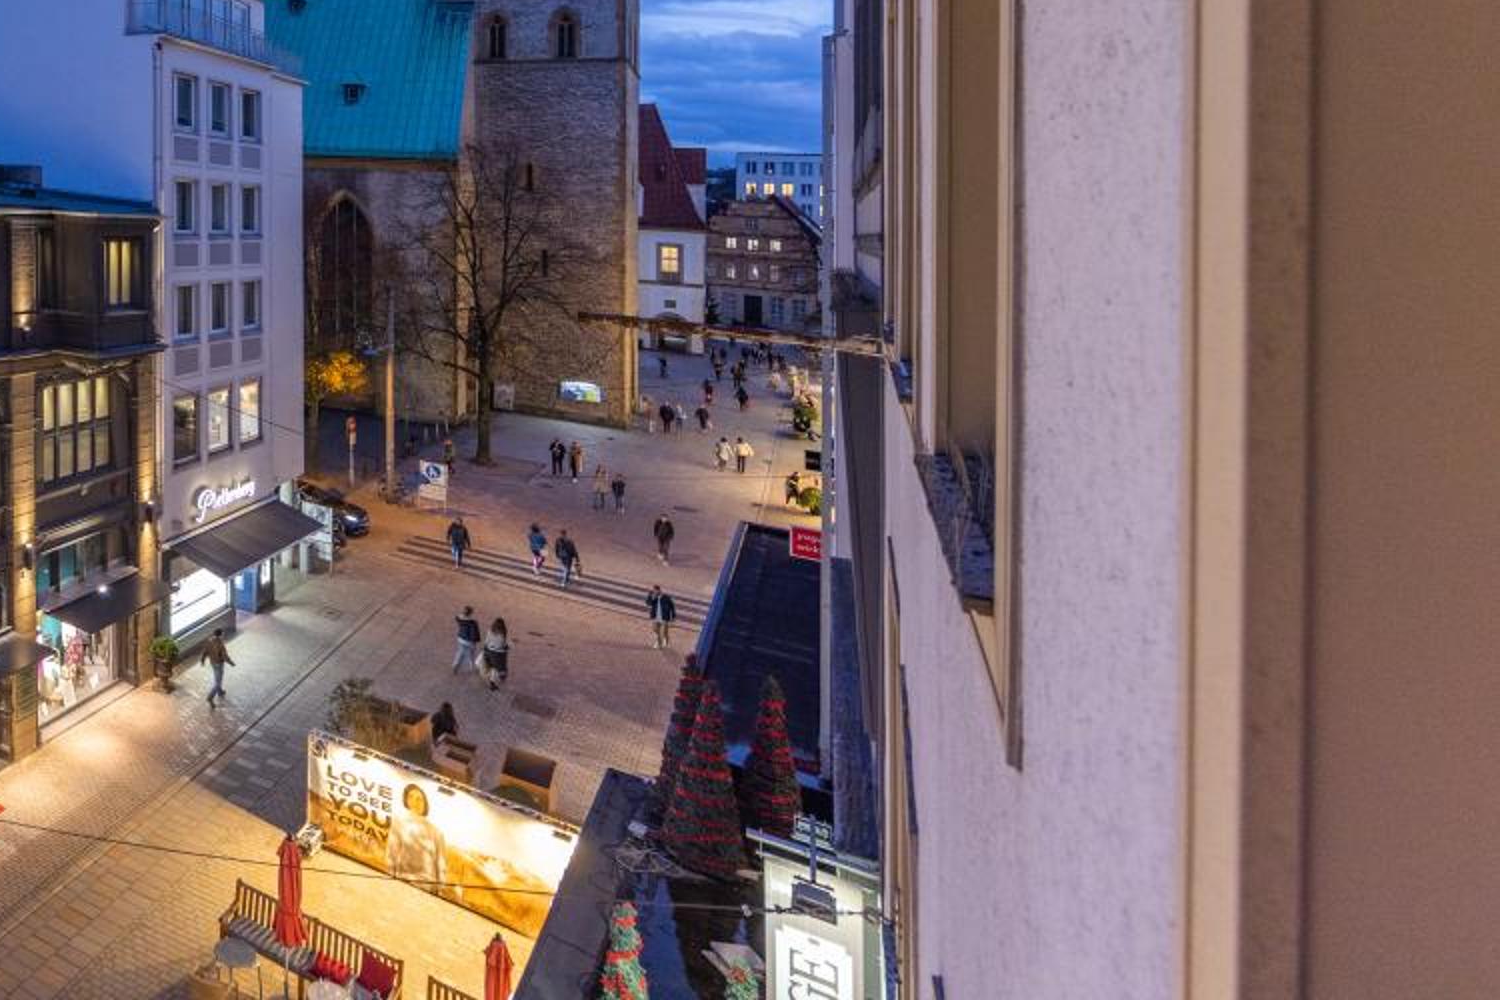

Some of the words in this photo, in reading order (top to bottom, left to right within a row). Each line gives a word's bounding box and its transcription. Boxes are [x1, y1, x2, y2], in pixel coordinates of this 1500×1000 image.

[327, 764, 392, 799] LOVE
[327, 781, 351, 797] TO
[357, 792, 392, 812] SEE
[327, 809, 389, 842] TODAY
[328, 792, 392, 829] YOU
